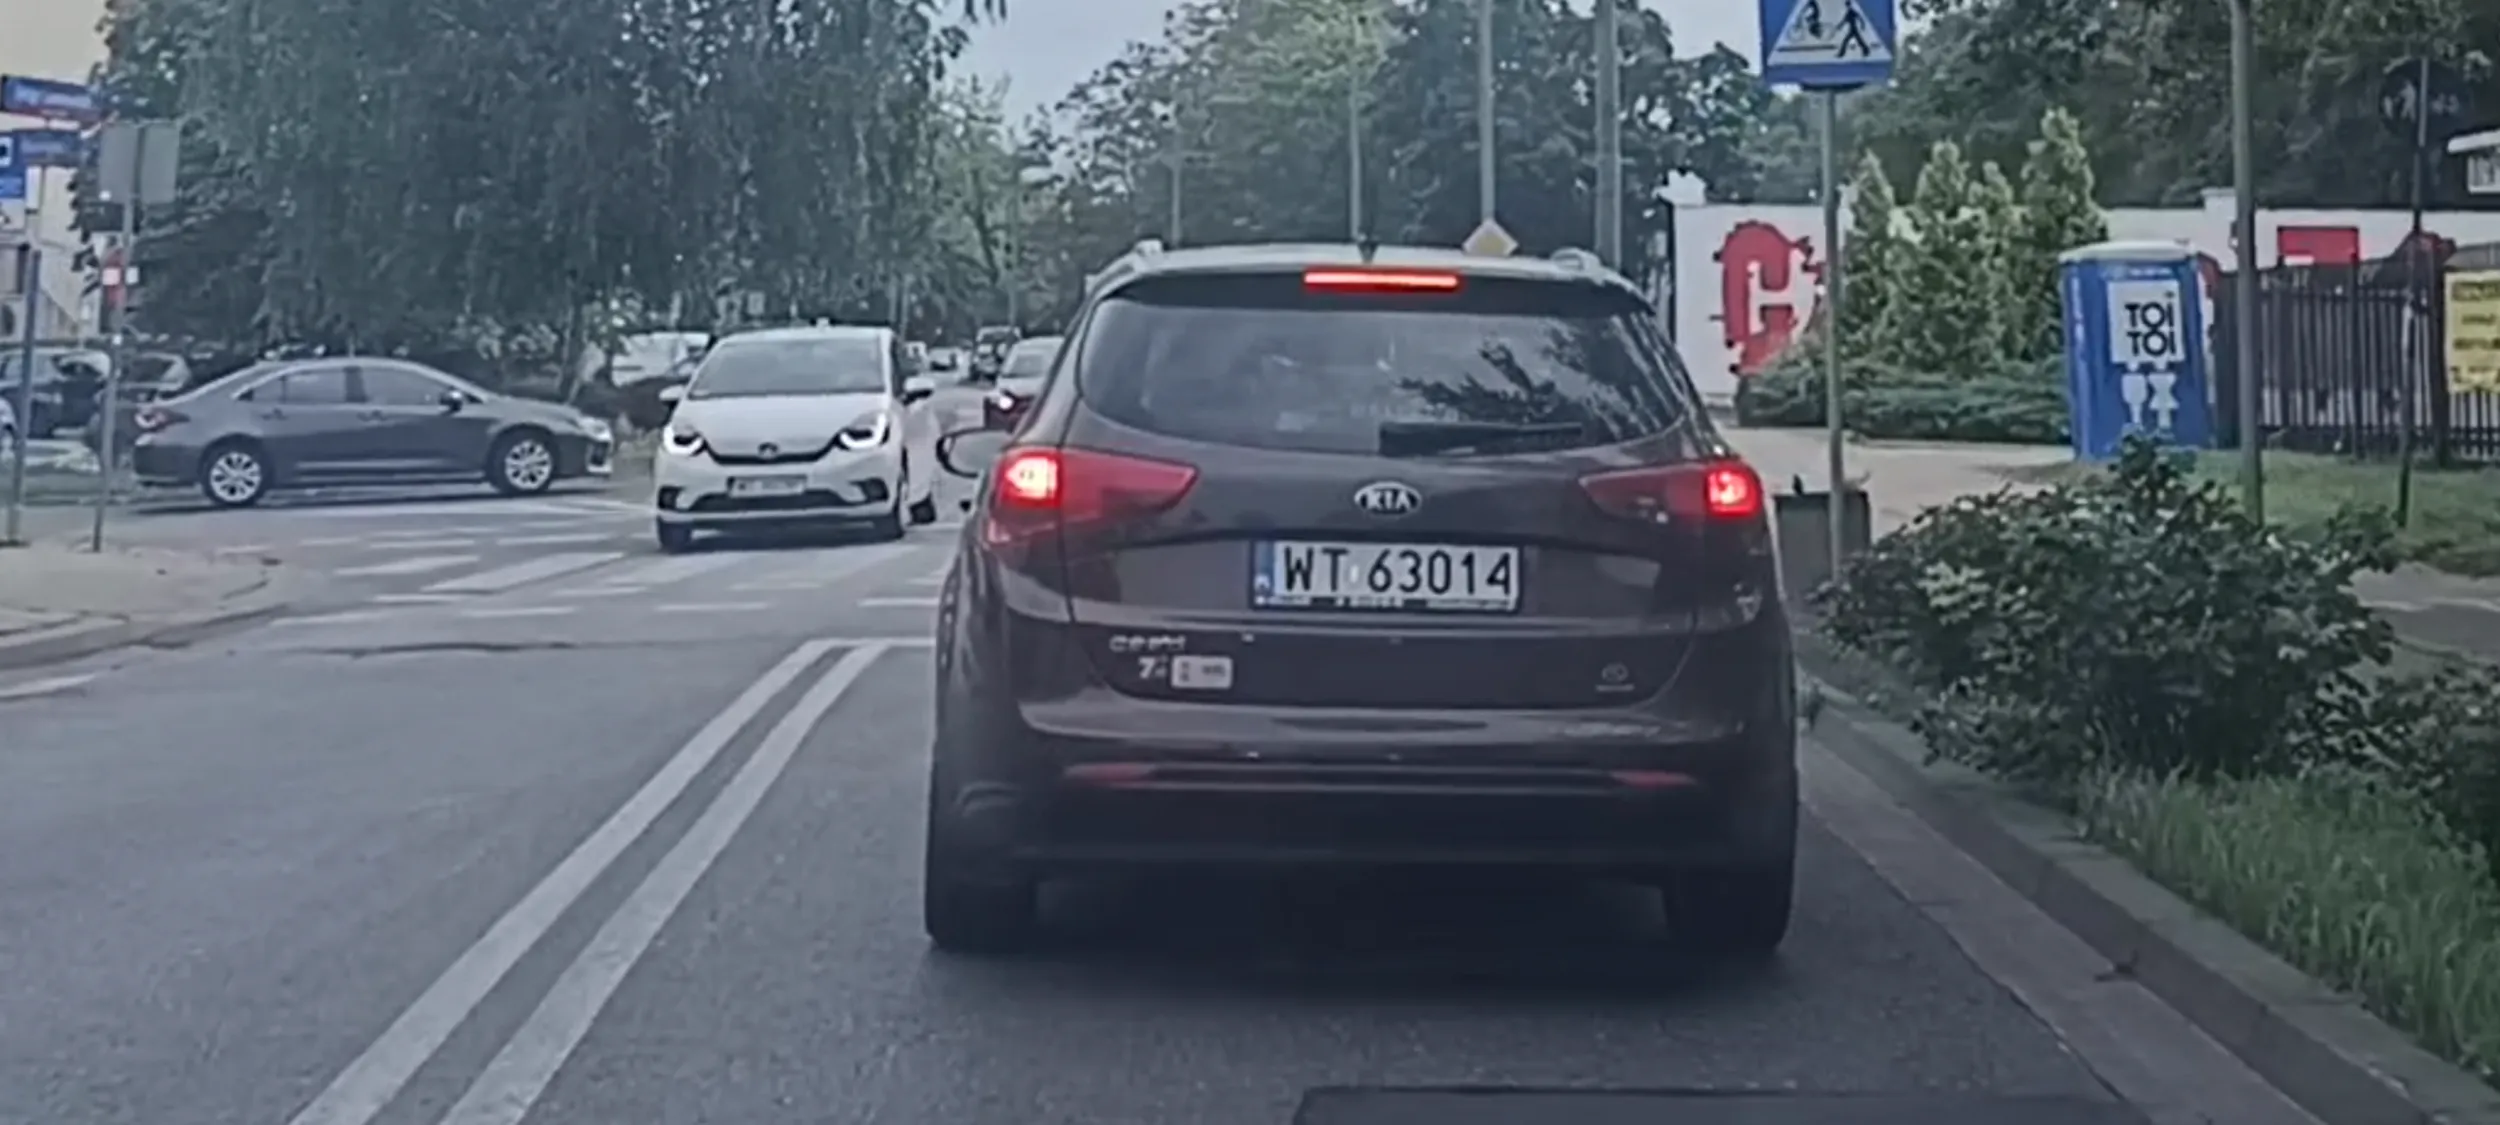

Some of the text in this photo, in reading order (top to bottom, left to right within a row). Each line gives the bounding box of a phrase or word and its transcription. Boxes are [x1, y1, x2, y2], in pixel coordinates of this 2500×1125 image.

[2126, 331, 2177, 357] TOI
[1366, 488, 1410, 511] KIA
[1284, 546, 1512, 596] WT 63014
